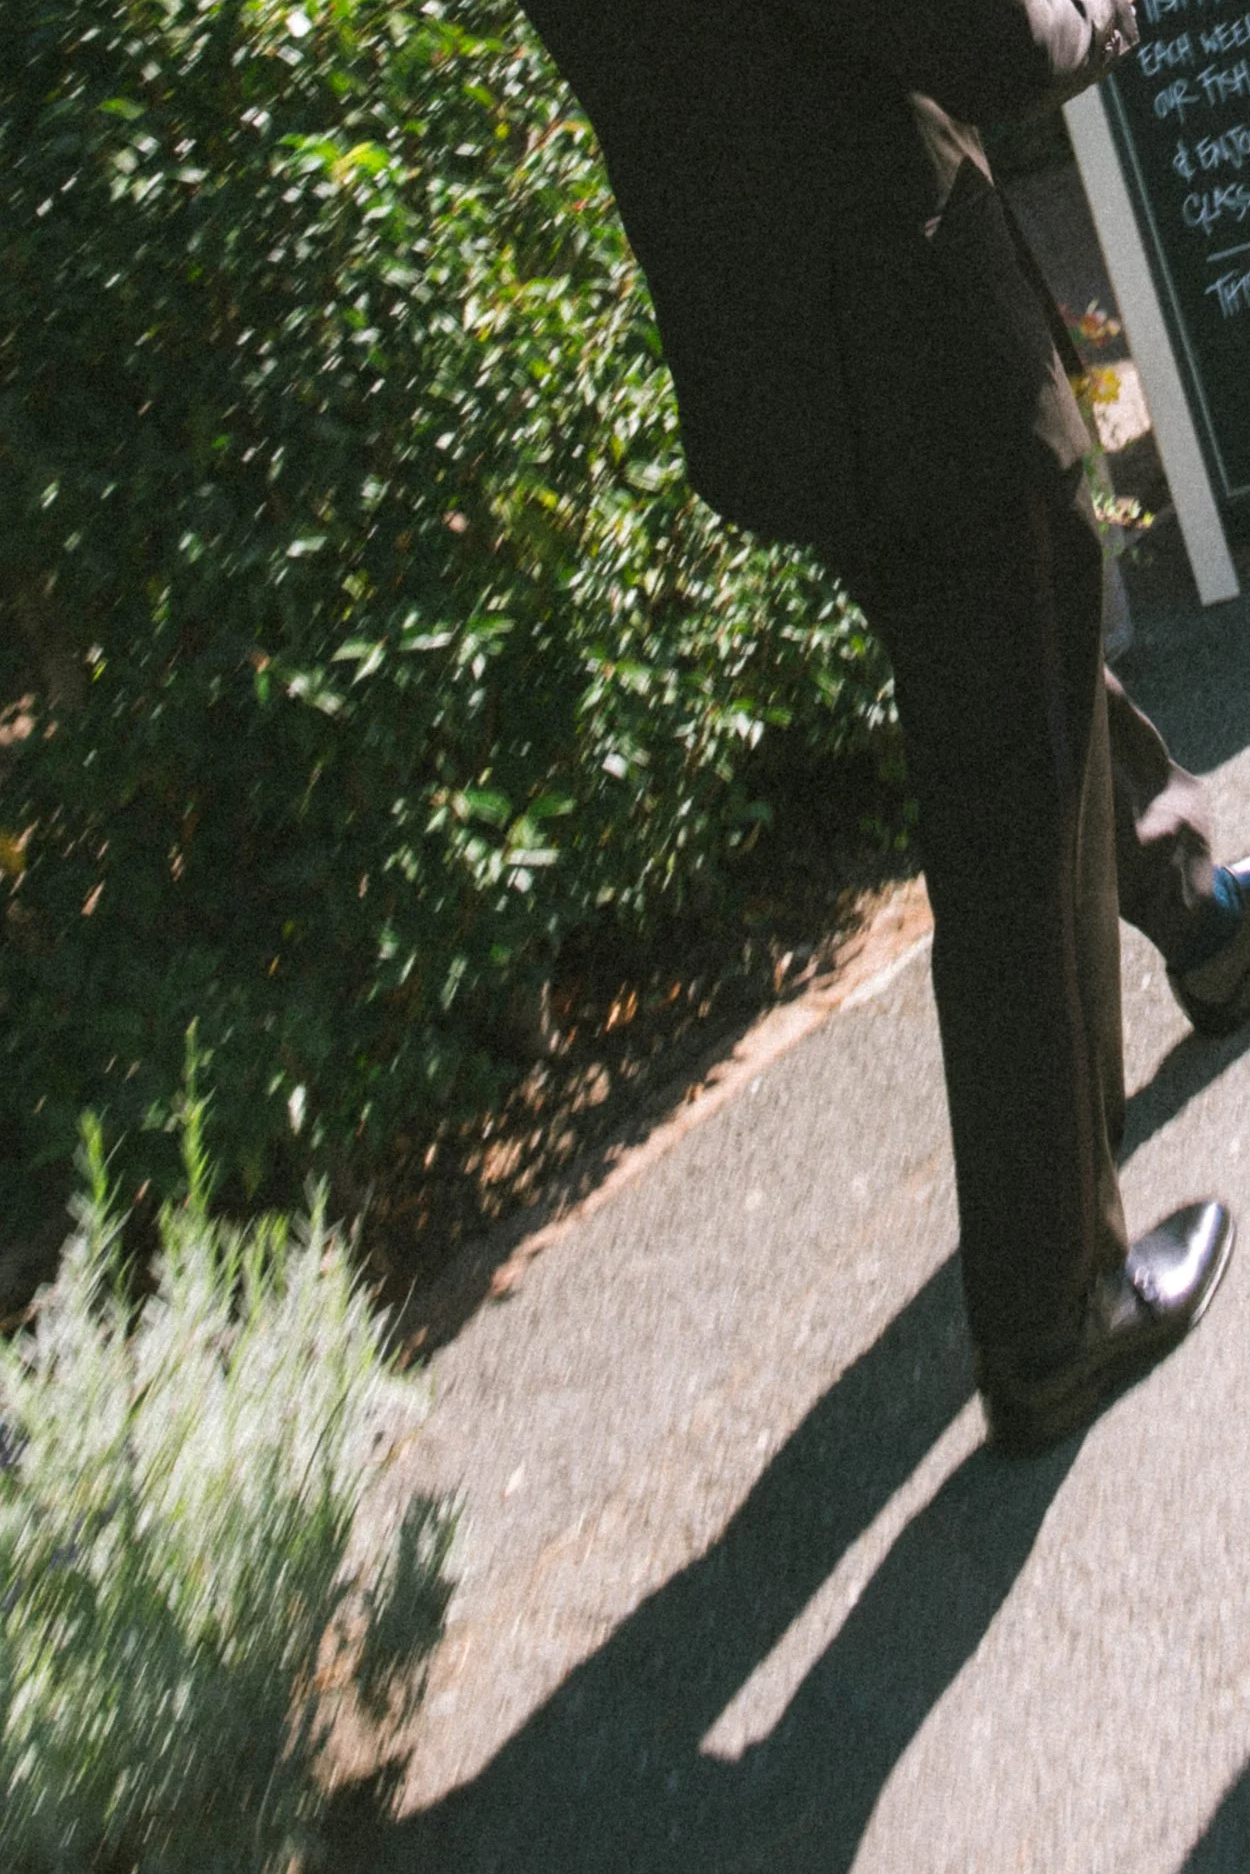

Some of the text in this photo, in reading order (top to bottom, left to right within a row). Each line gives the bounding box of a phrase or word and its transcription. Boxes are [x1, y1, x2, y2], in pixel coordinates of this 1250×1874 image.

[1137, 31, 1194, 76] EACH
[1154, 79, 1200, 124] OUR
[1172, 139, 1196, 183] &
